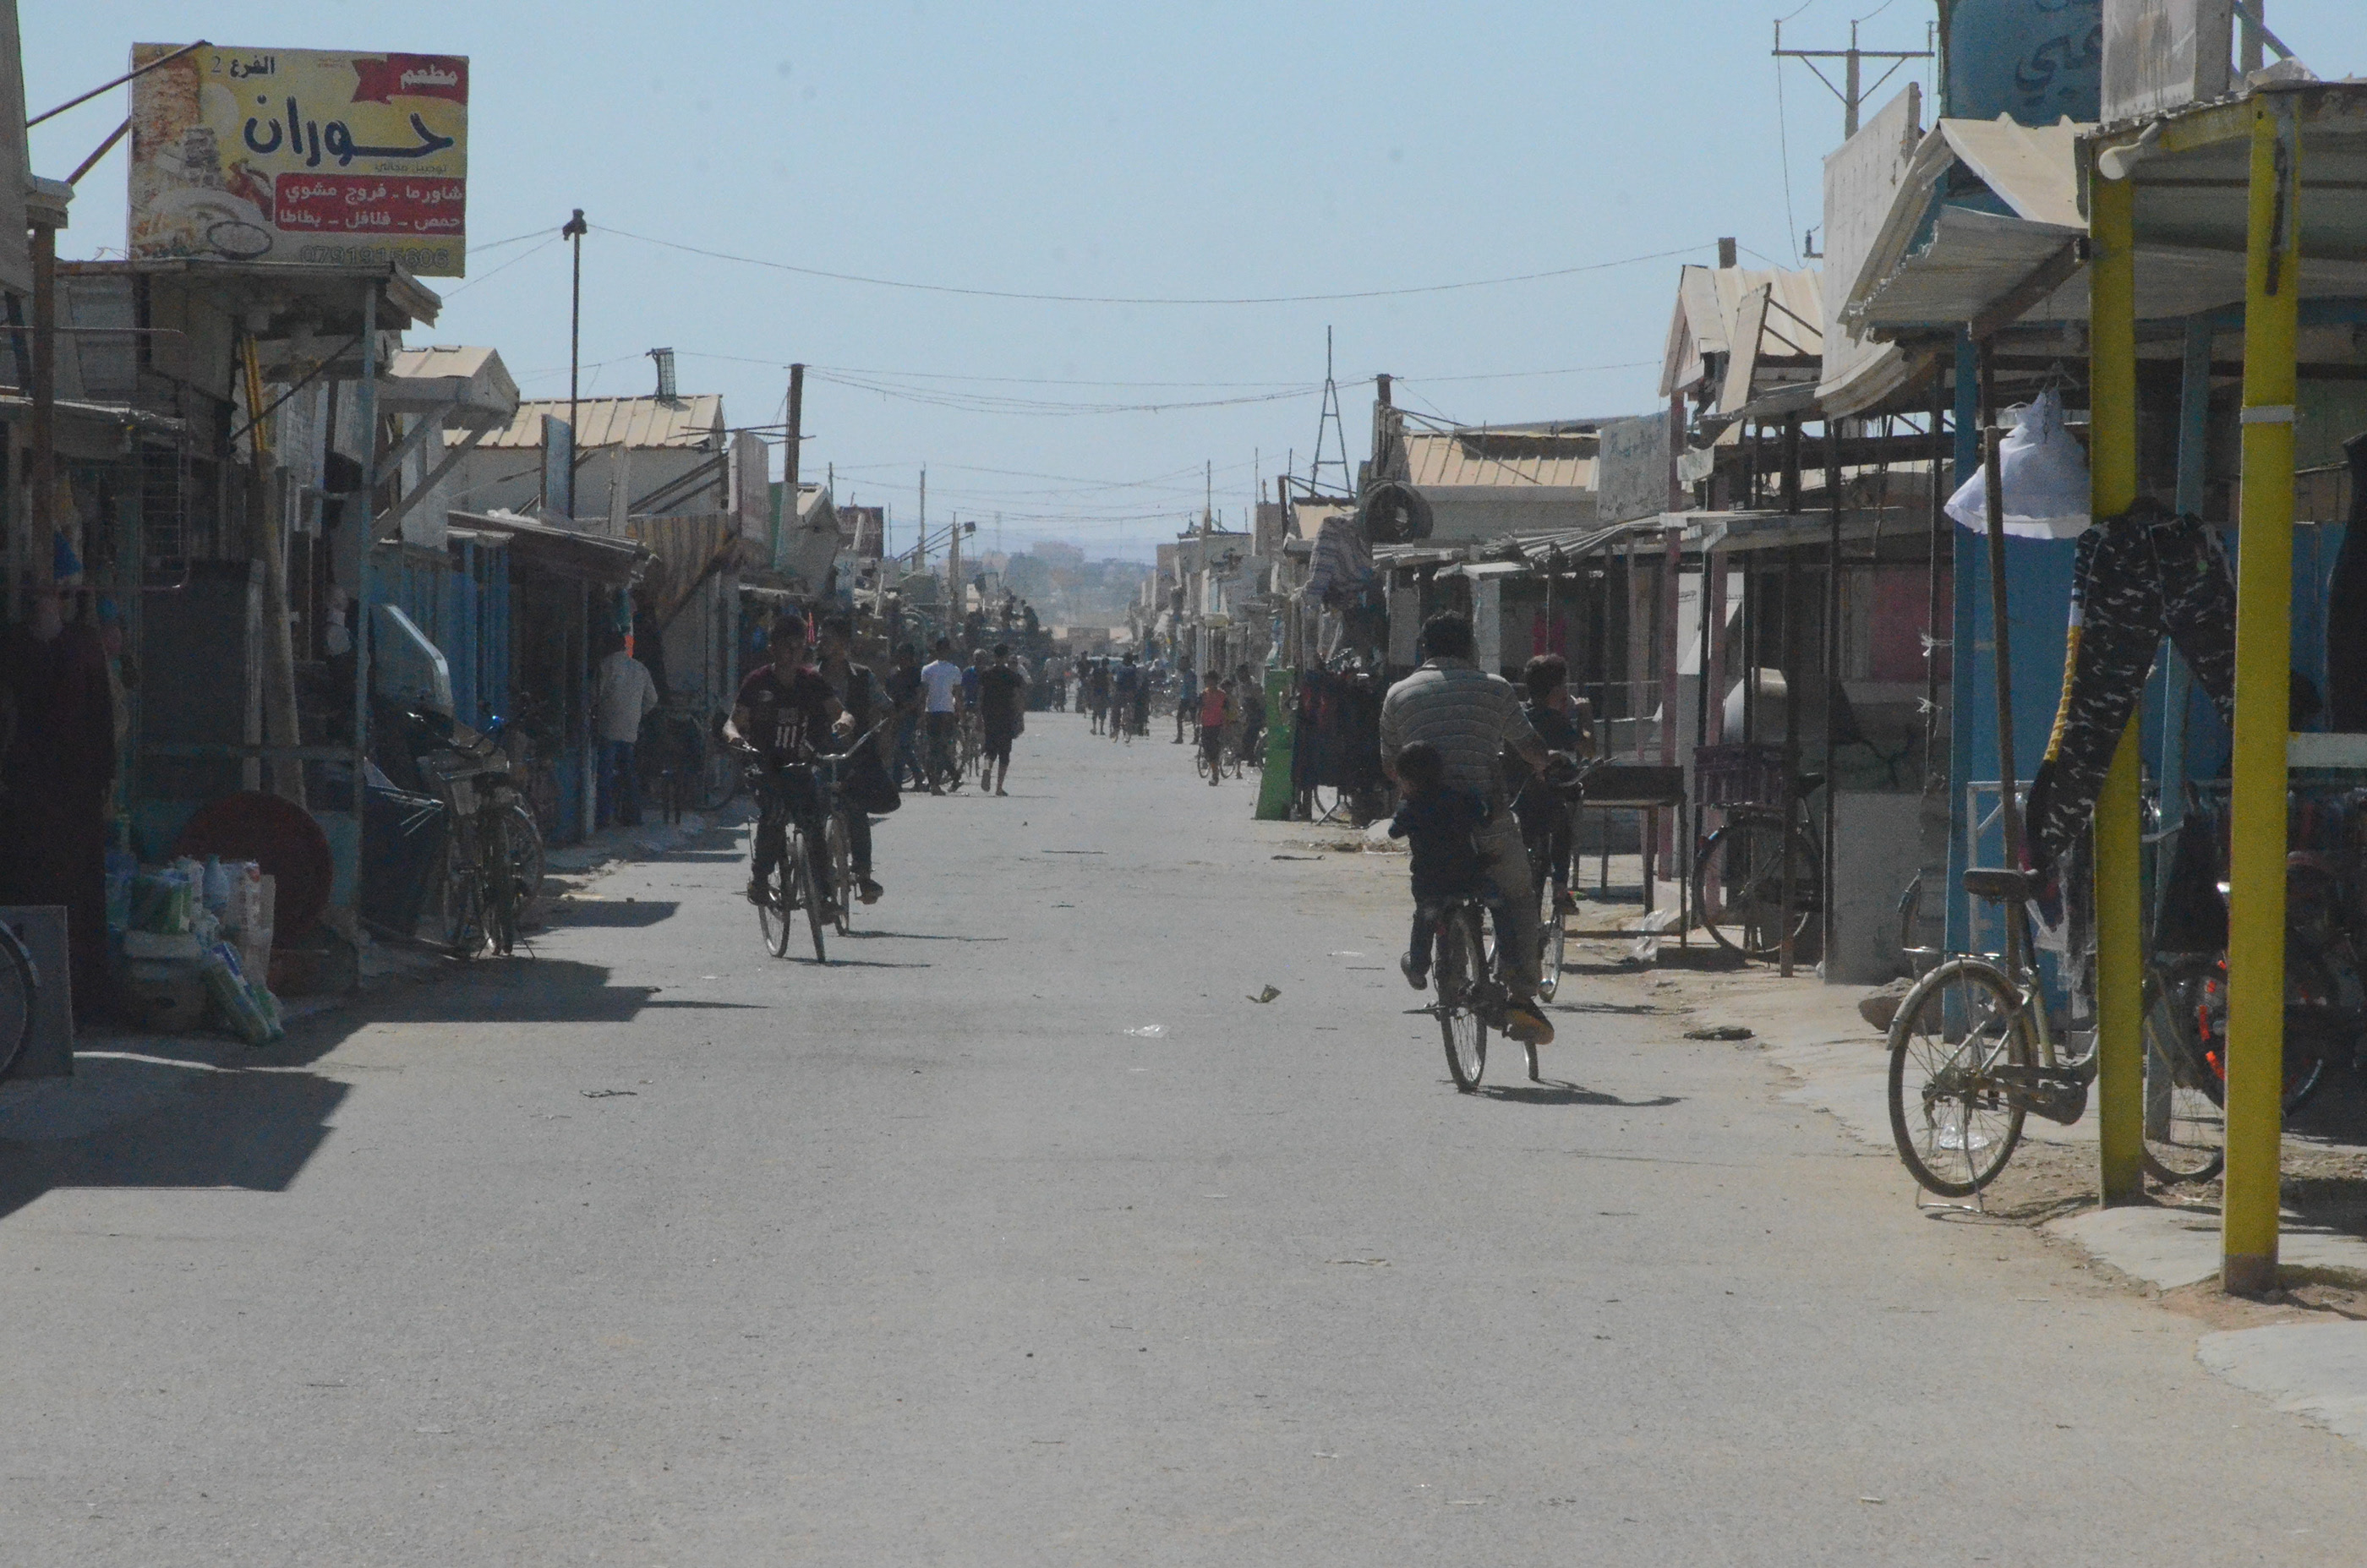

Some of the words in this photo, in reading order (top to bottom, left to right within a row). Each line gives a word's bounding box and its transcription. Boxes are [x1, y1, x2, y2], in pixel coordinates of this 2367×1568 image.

[211, 56, 221, 74] 2
[230, 55, 275, 78] الفرع
[400, 64, 457, 90] مطعم
[243, 95, 454, 167] حوران
[285, 182, 337, 203] مشوي
[345, 183, 386, 205] فروج
[406, 184, 463, 204] شاورما
[345, 211, 391, 229] فلافل
[414, 215, 461, 231] حمص
